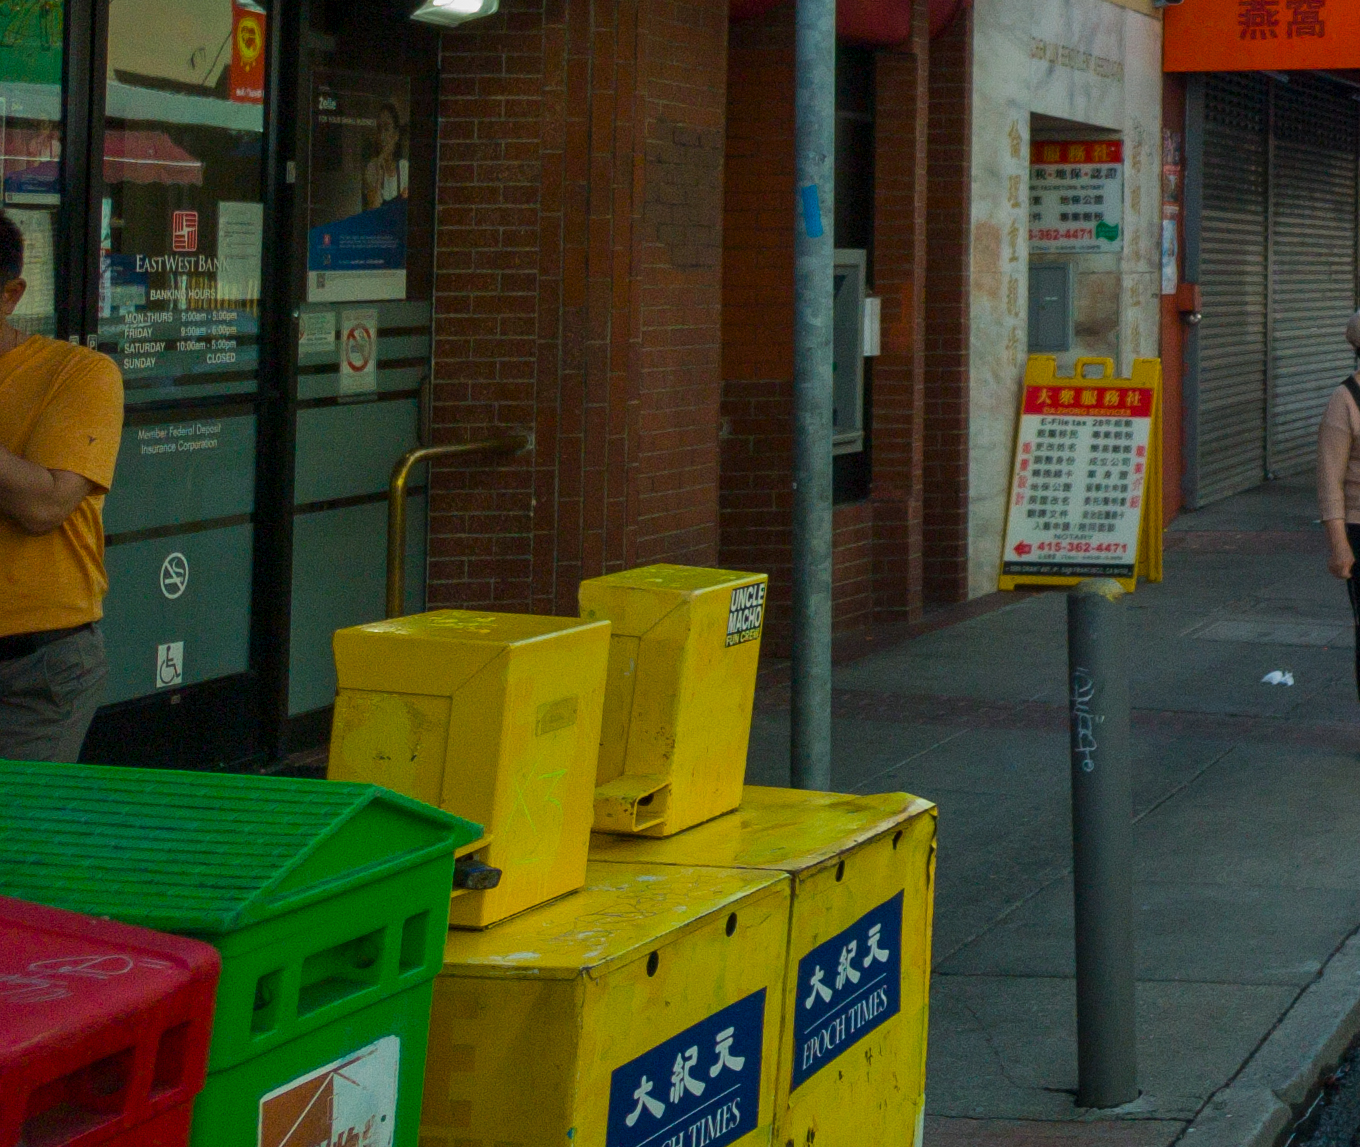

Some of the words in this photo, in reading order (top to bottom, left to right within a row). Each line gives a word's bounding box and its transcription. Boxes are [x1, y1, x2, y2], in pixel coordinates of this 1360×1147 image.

[1031, 143, 1109, 163] 服務社
[150, 289, 187, 300] BANKING
[188, 286, 216, 299] HOURS
[124, 312, 174, 323] MON-THURS
[180, 311, 207, 322] 9:00am
[212, 311, 238, 322] 5:00pm
[124, 327, 153, 339] FRIDAY
[180, 326, 207, 337] 9:00am
[211, 325, 237, 337] 6:00pm
[124, 341, 166, 354] SATURDAY
[176, 341, 206, 351] 10:00am
[211, 340, 237, 351] 5:00pm
[123, 358, 156, 369] SUNDAY
[206, 353, 236, 364] CLOSED
[138, 428, 166, 440] Member
[169, 424, 195, 436] Federal
[196, 423, 221, 434] Deposit
[141, 444, 176, 455] Insurance
[177, 438, 218, 452] Corporation
[1053, 533, 1094, 541] NOTARY
[1036, 541, 1128, 554] 415-362-4471
[730, 583, 766, 612] UNCLE
[727, 605, 762, 635] MACHO
[726, 635, 740, 646] FUN
[805, 923, 890, 1010] 大紀元
[802, 1010, 847, 1071] EPOCH
[847, 984, 888, 1040] TIMES
[625, 1026, 746, 1128] 大紀元
[687, 1097, 742, 1147] TIMES
